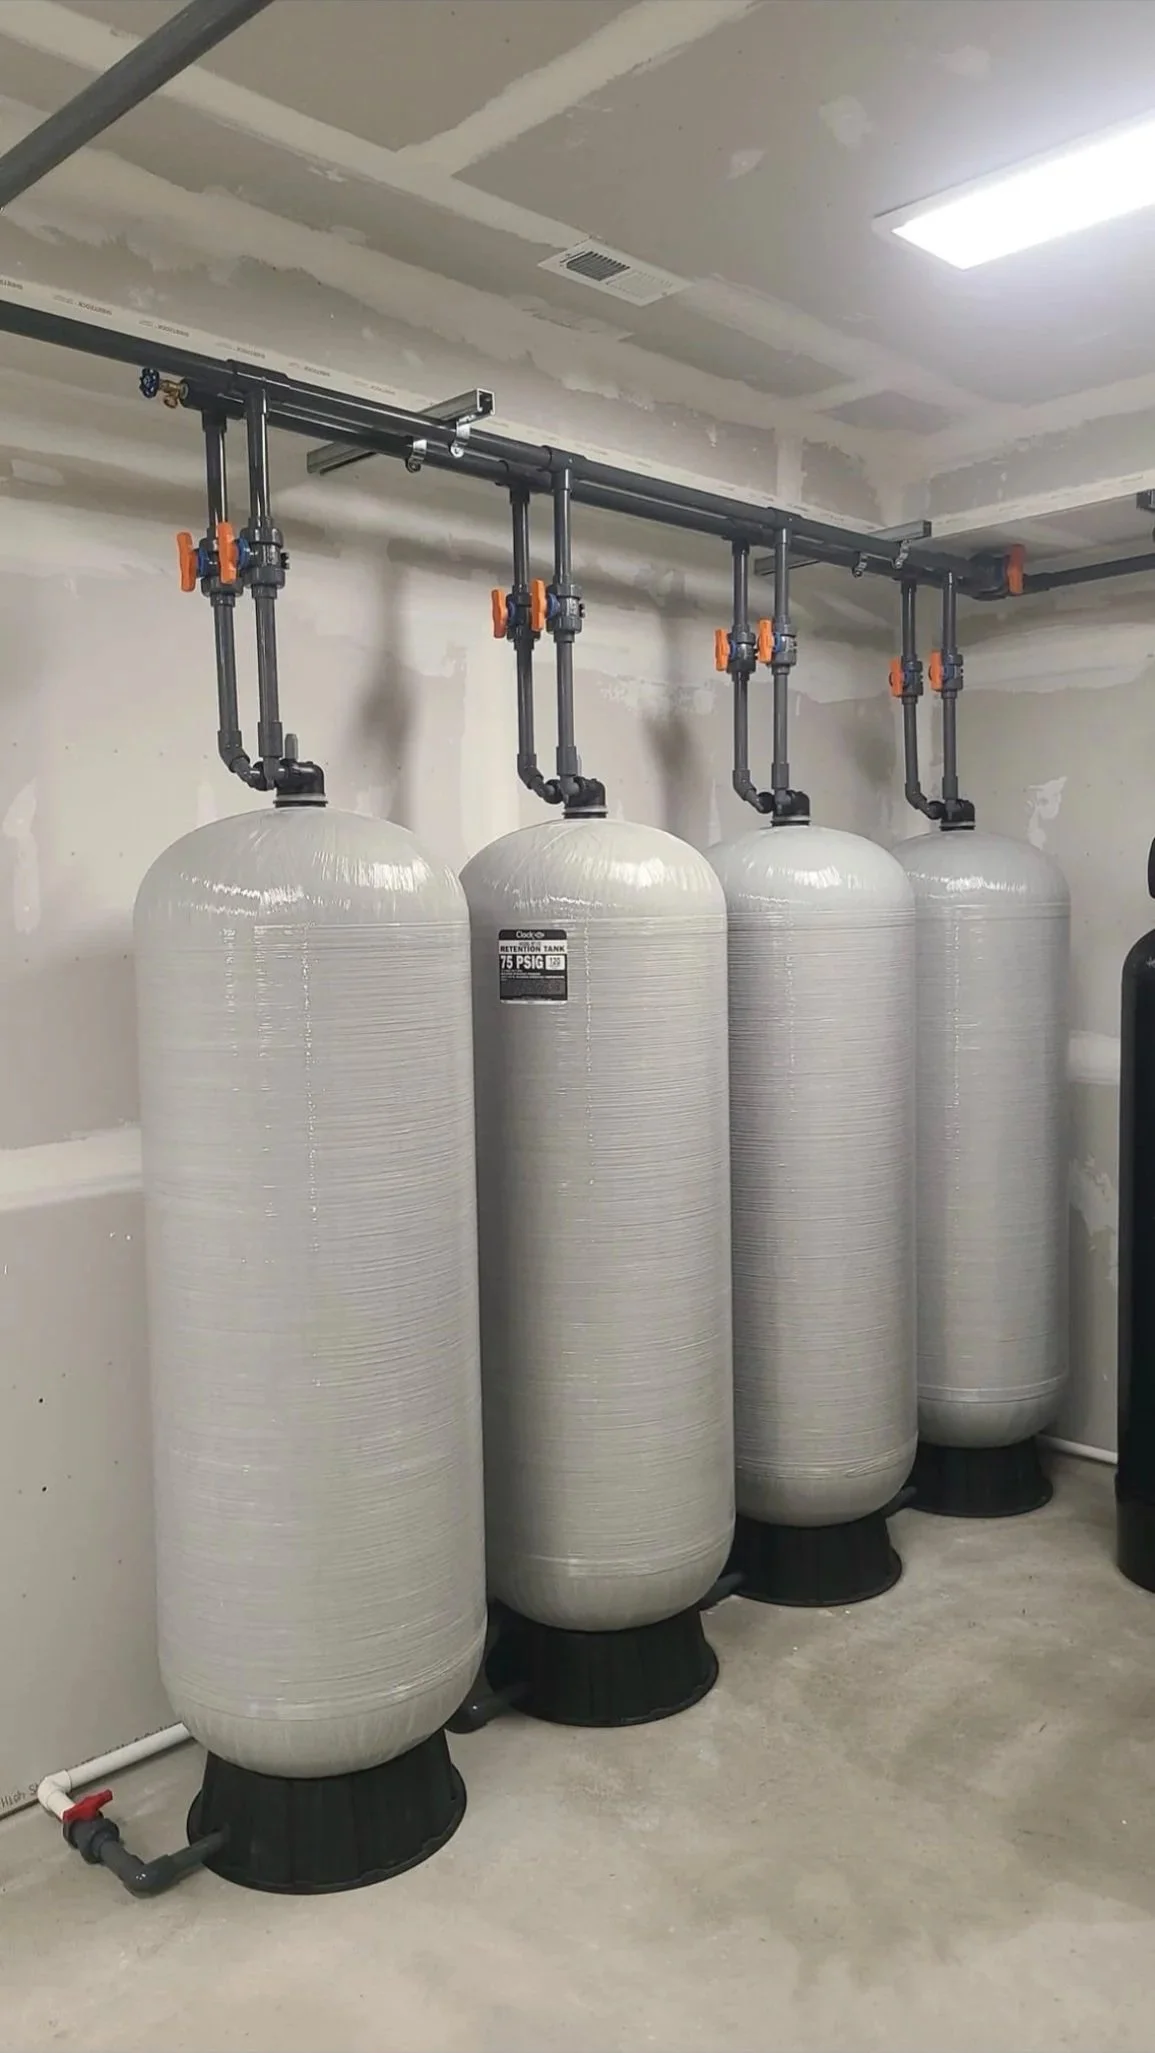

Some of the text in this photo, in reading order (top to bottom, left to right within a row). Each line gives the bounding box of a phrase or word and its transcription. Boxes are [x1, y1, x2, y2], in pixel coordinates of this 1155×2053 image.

[500, 945, 565, 953] RETENTION TANK
[500, 955, 544, 969] 75 PSIG
